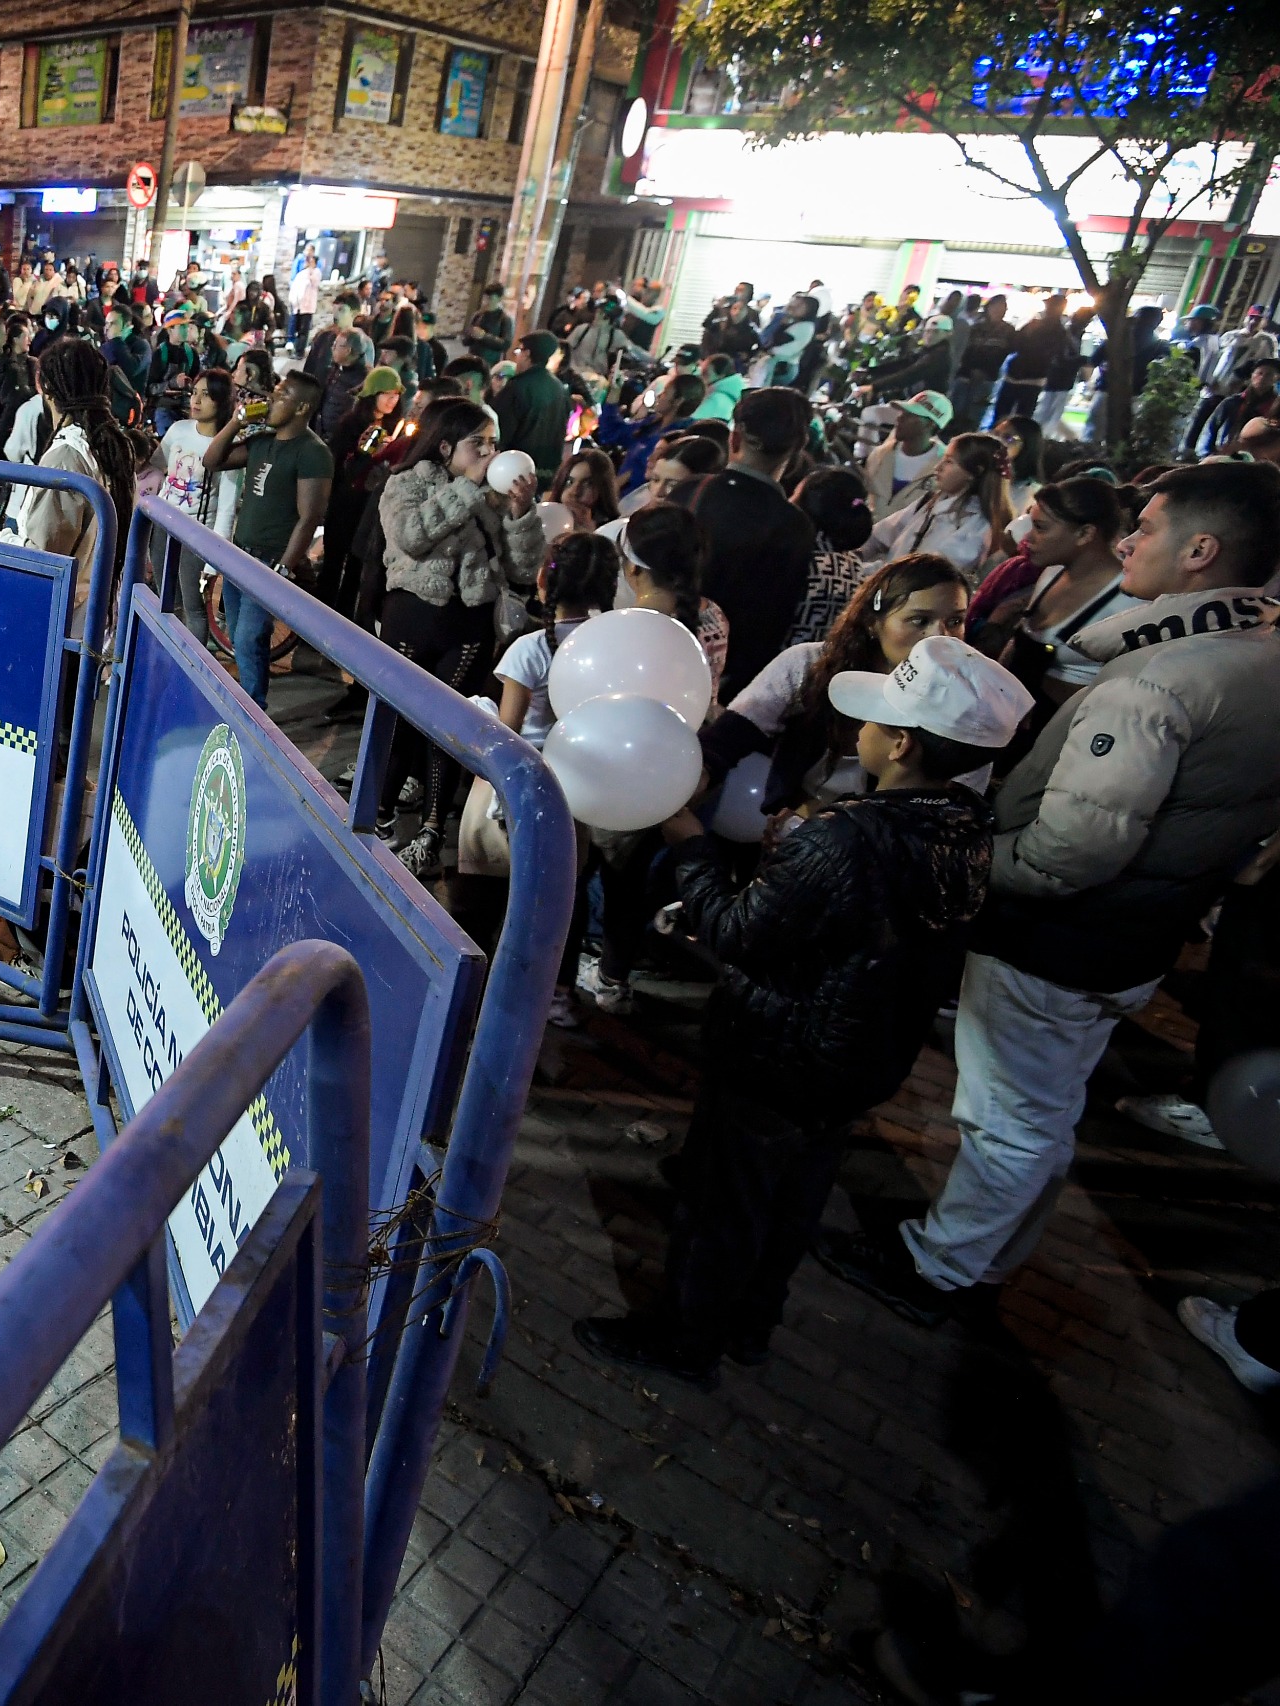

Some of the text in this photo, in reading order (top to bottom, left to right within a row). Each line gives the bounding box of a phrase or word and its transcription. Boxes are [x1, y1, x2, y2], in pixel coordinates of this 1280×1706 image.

[200, 914, 216, 936] PATRIA
[122, 909, 166, 1052] POLICÍA
[126, 986, 144, 1051] DE
